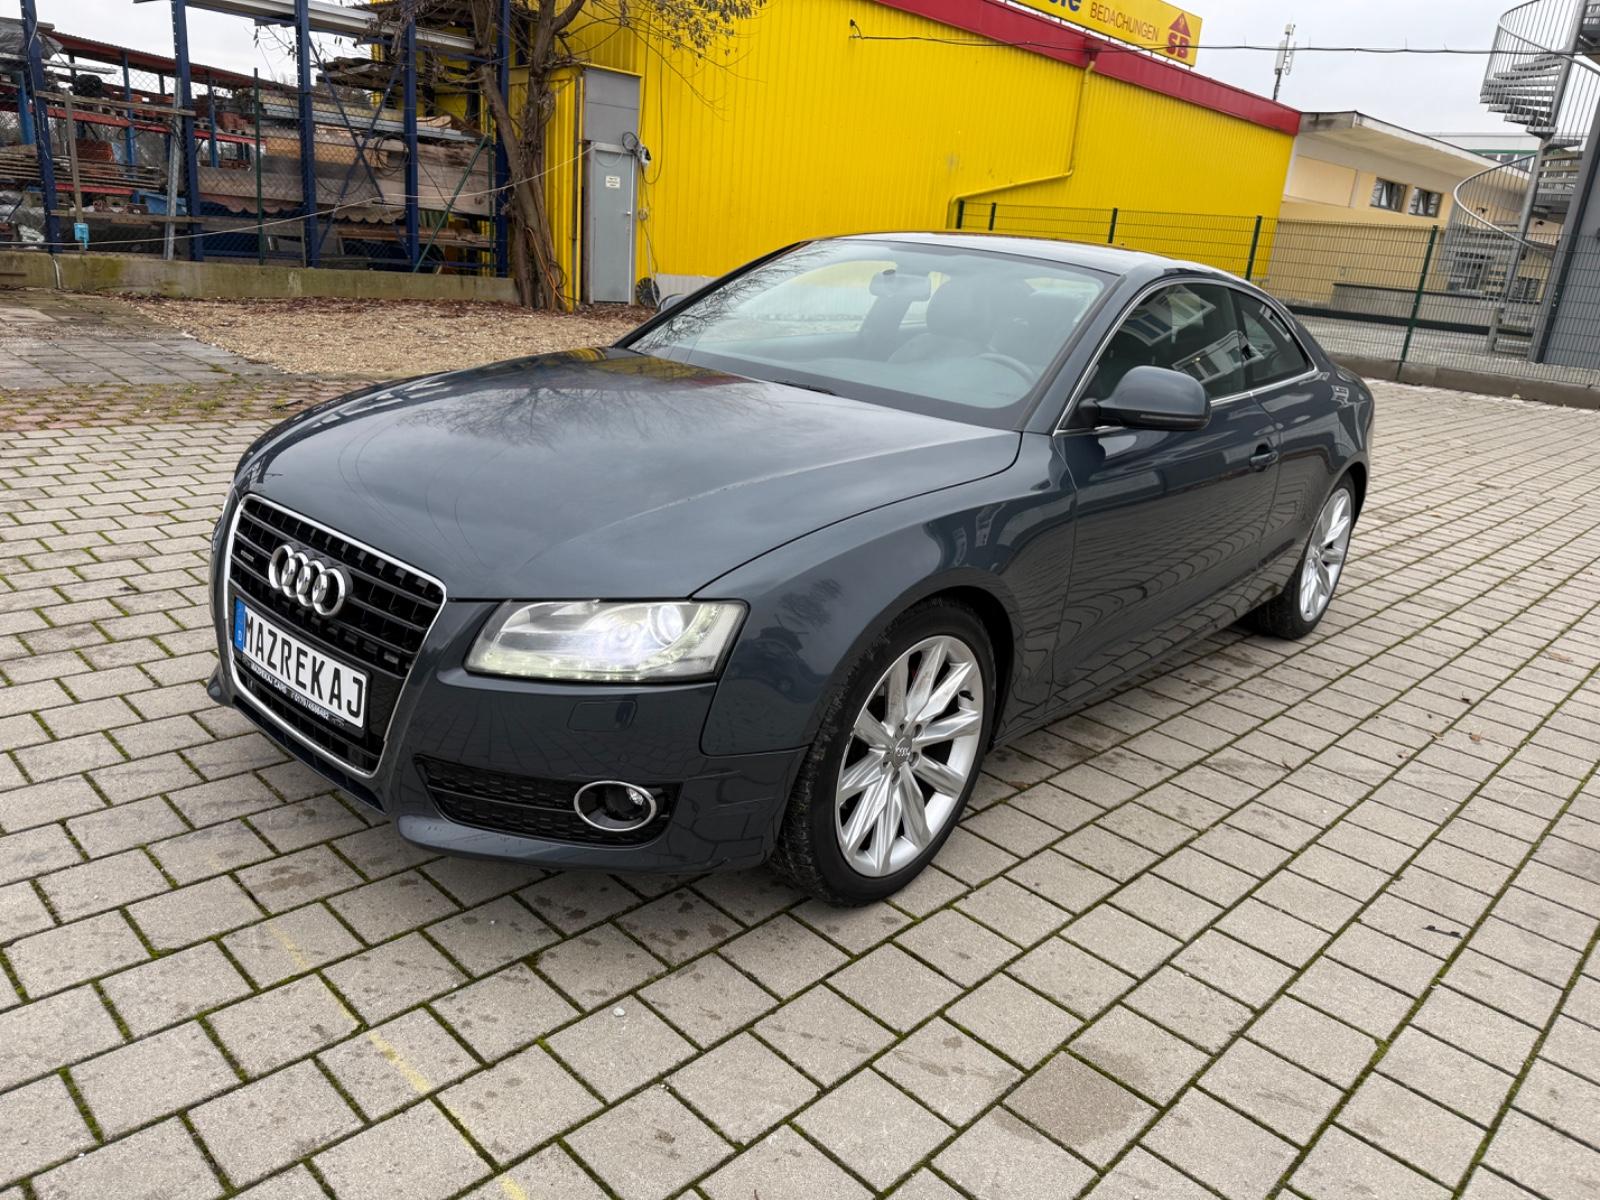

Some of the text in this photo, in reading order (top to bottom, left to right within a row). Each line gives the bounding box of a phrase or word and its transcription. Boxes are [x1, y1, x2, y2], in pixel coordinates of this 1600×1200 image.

[1090, 3, 1158, 41] BEDACHUNGEN
[1167, 32, 1190, 58] SB
[244, 612, 363, 718] MAZREKAJ
